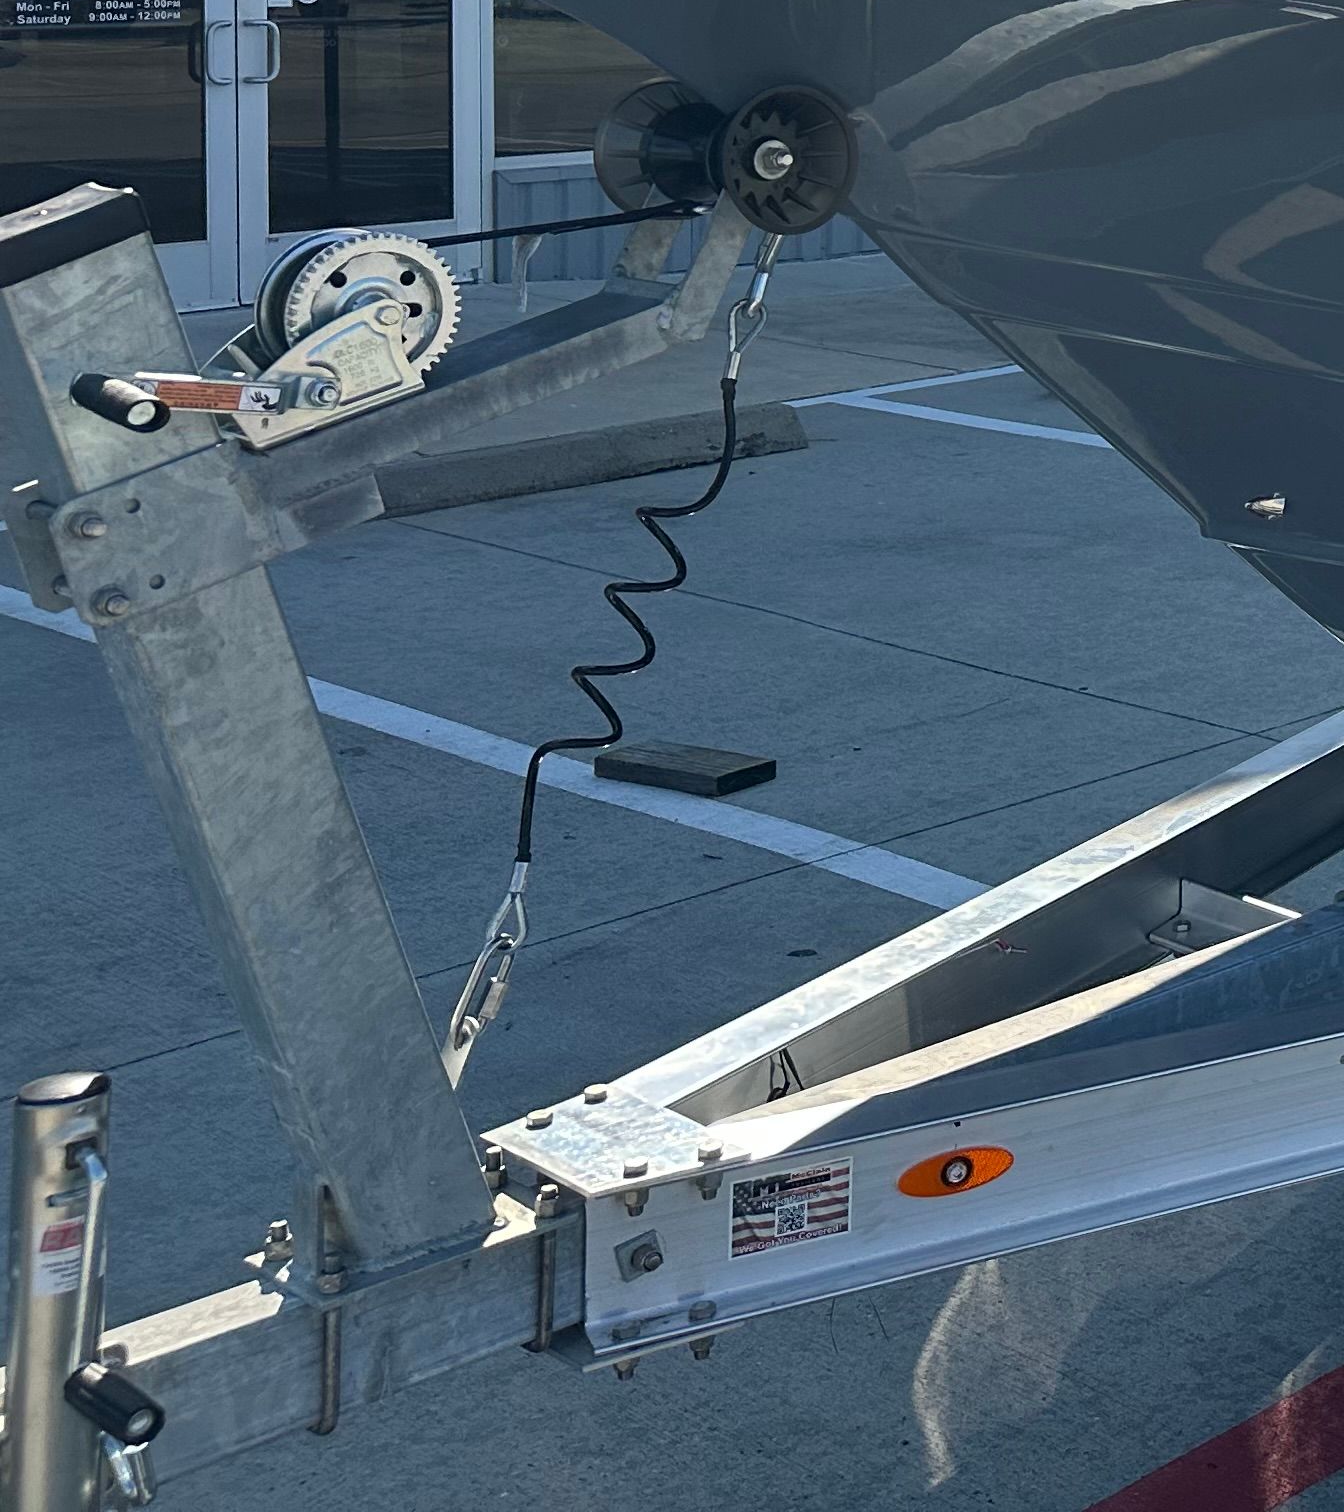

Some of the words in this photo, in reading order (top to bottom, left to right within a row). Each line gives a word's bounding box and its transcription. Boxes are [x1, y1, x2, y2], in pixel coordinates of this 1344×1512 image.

[16, 2, 43, 12] Mon
[53, 1, 70, 11] Fri
[143, 0, 181, 8] 5:00PM
[17, 14, 71, 26] Saturday
[777, 1235, 798, 1246] You
[799, 1223, 842, 1240] Covered!
